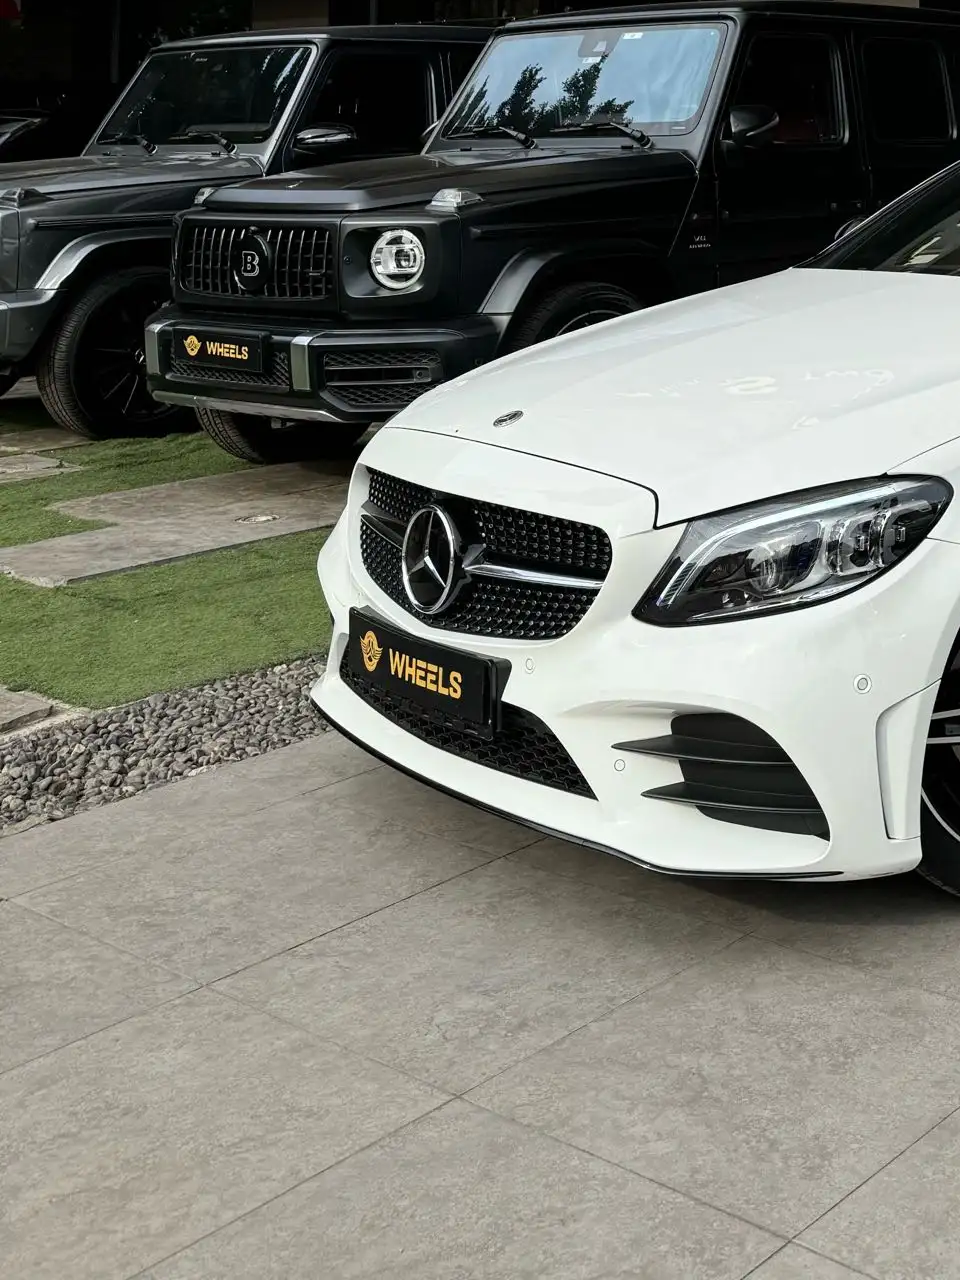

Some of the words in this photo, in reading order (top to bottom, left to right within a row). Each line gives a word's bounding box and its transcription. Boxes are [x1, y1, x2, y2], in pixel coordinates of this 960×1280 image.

[241, 250, 260, 277] B
[206, 341, 249, 360] WHEELS
[389, 648, 462, 699] WHEELS
